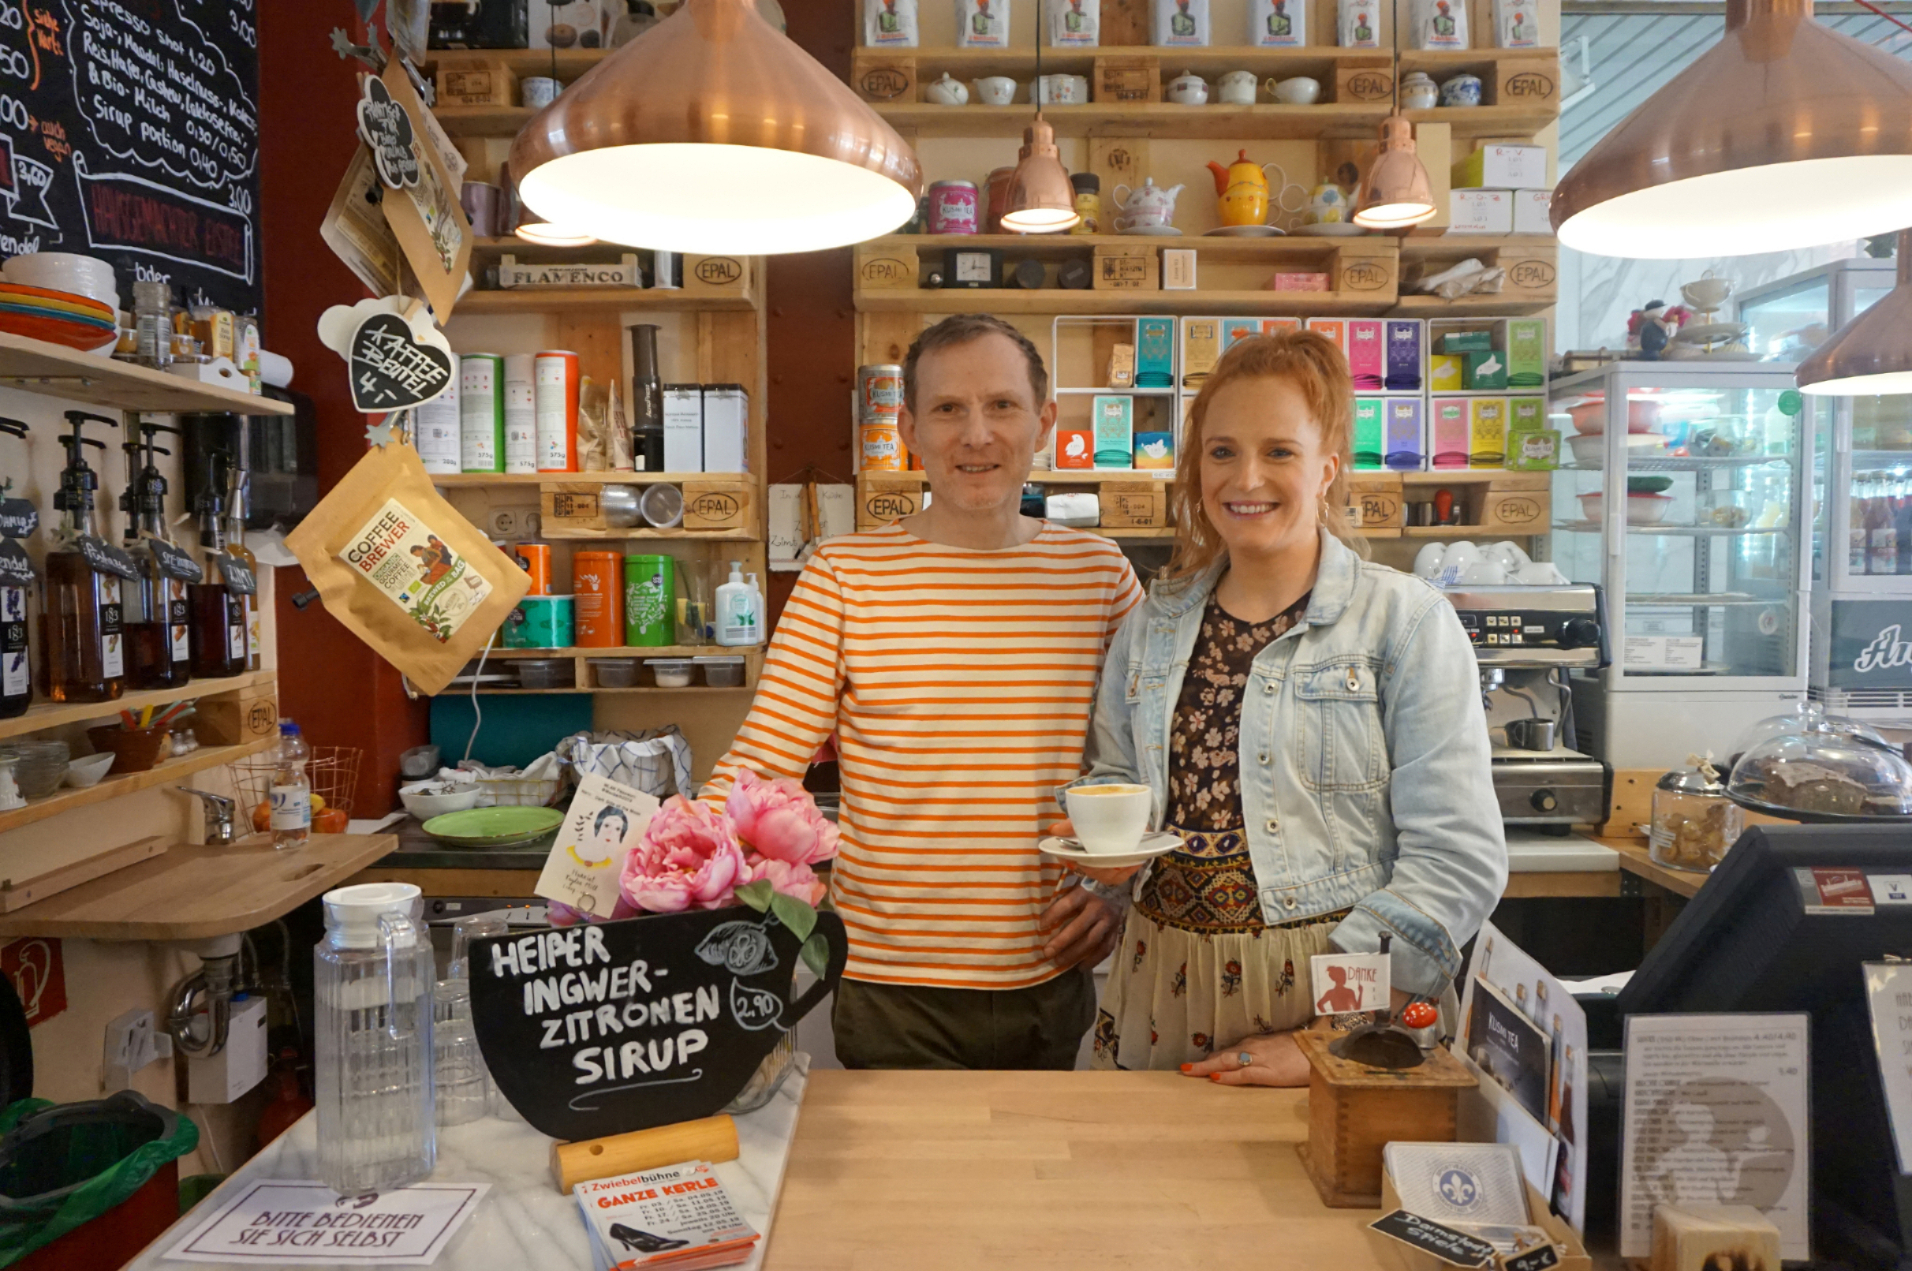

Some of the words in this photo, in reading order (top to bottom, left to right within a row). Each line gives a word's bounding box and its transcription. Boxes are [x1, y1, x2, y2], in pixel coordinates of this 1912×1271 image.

[867, 76, 901, 92] EPAL
[1354, 79, 1387, 94] EPAL
[1513, 79, 1546, 96] EPAL
[94, 95, 132, 135] Sirup
[135, 86, 170, 123] Milch
[513, 271, 623, 285] FLAMENCO
[702, 263, 736, 279] EPAL
[1350, 266, 1383, 283] EPAL
[1517, 266, 1550, 282] EPAL
[365, 324, 449, 385] KAFFEE
[699, 500, 732, 516] EPAL
[874, 499, 907, 516] EPAL
[1502, 504, 1535, 518] EPAL
[347, 510, 400, 564] COFFEE
[359, 520, 411, 573] BREWER
[378, 557, 406, 585] GOURMET
[384, 562, 411, 590] COFFEE
[423, 580, 447, 606] BREWED
[451, 560, 467, 581] BAG
[1347, 966, 1377, 983] DANKE
[523, 959, 669, 1016] INGWER-
[539, 984, 720, 1049] ZITRONEN
[1488, 1012, 1509, 1040] KUSMI
[1507, 1030, 1519, 1051] TEA
[572, 1029, 709, 1085] SIRUP
[591, 1170, 680, 1191] Zwiebelbühne
[597, 1189, 658, 1209] GANZE
[662, 1177, 719, 1196] KERLE
[250, 1211, 314, 1228] BITTE
[312, 1212, 425, 1229] BEDIENEN
[229, 1228, 269, 1245] SIE
[267, 1230, 324, 1246] SICH
[323, 1230, 405, 1247] SELBST
[1406, 1226, 1465, 1256] Spiele
